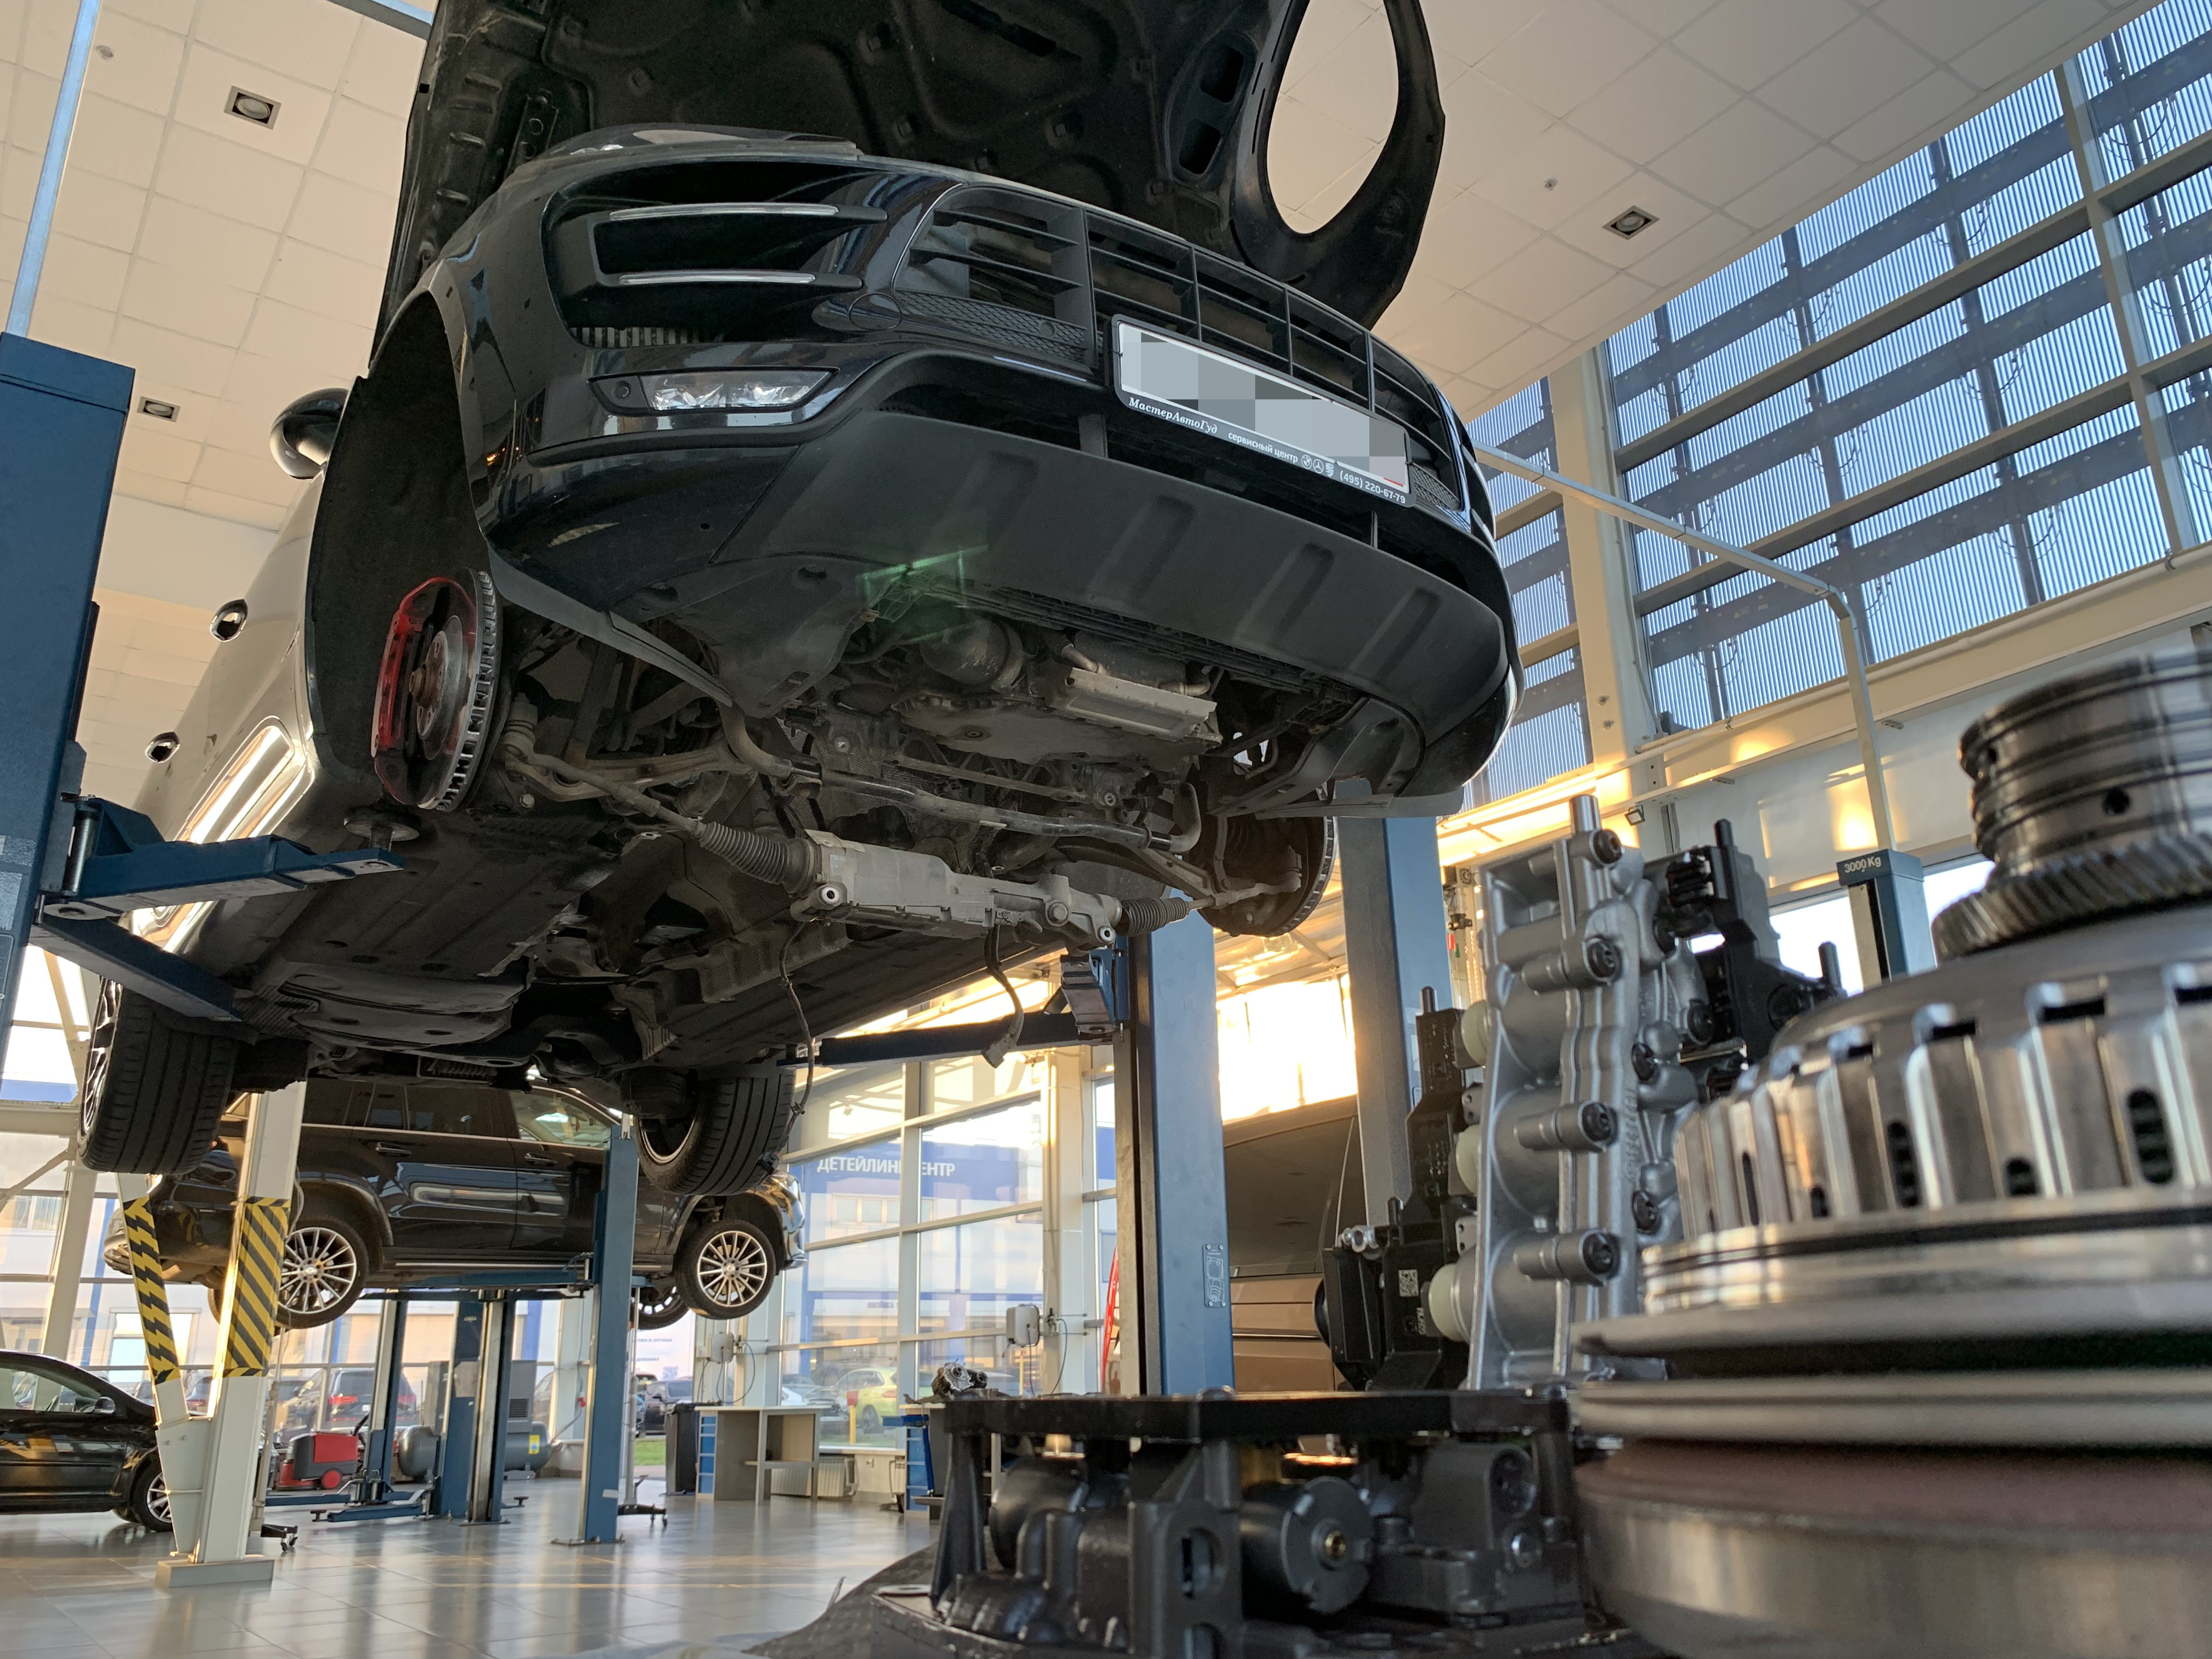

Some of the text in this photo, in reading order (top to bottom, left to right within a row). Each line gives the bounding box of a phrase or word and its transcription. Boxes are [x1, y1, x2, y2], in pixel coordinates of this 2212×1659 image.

[1128, 397, 1406, 504] МастерАвтоГуд сервисный центр (495) 220-67-79
[1844, 856, 1882, 873] 3000 Kg
[816, 1155, 956, 1177] ДЕТЕЙЛИН ЕНТР
